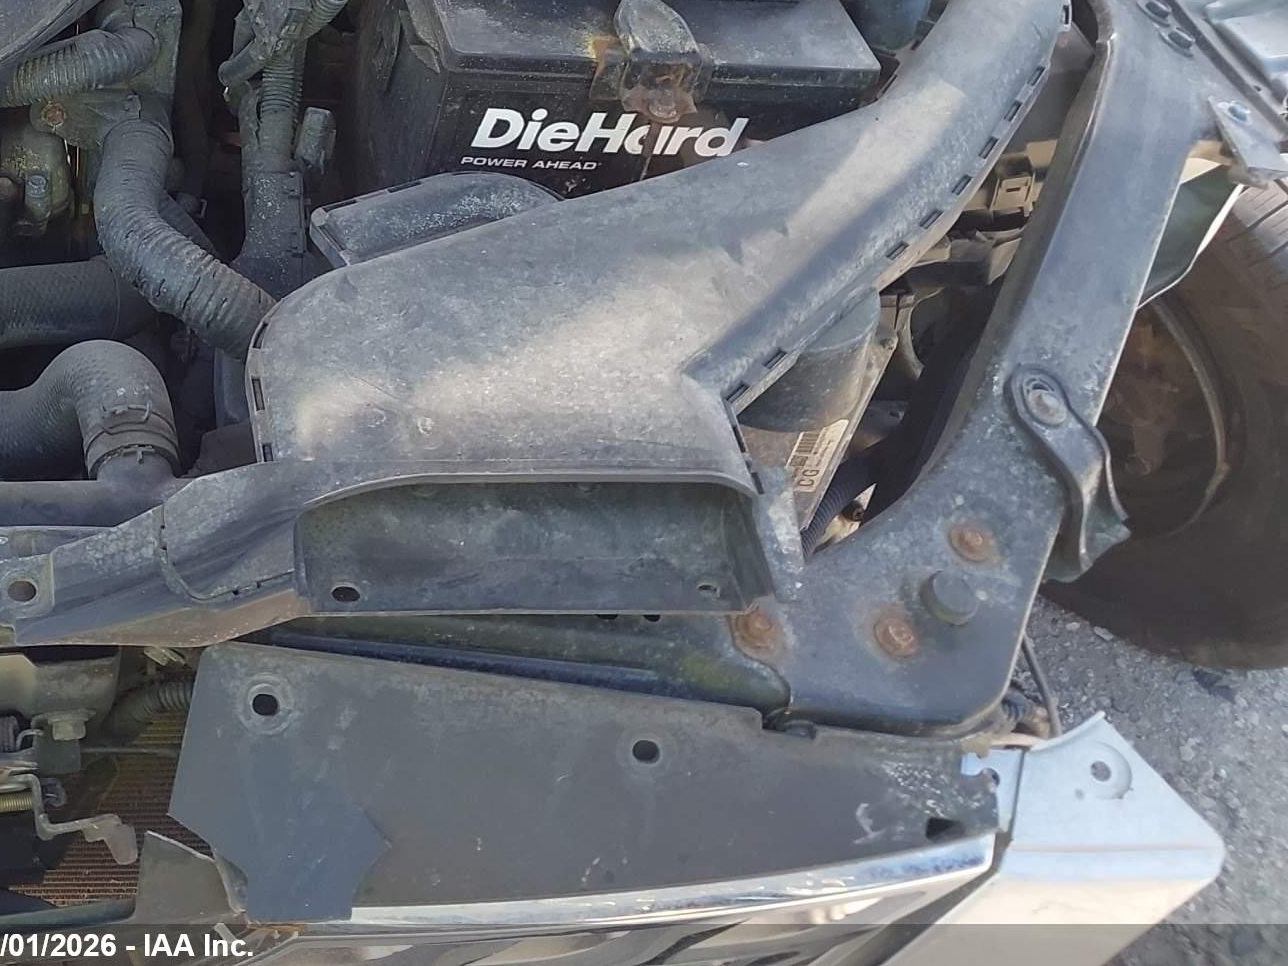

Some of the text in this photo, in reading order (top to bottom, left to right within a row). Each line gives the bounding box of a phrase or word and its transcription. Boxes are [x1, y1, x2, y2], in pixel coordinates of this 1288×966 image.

[471, 108, 750, 156] DieHard
[461, 156, 598, 170] POWER AHEAD
